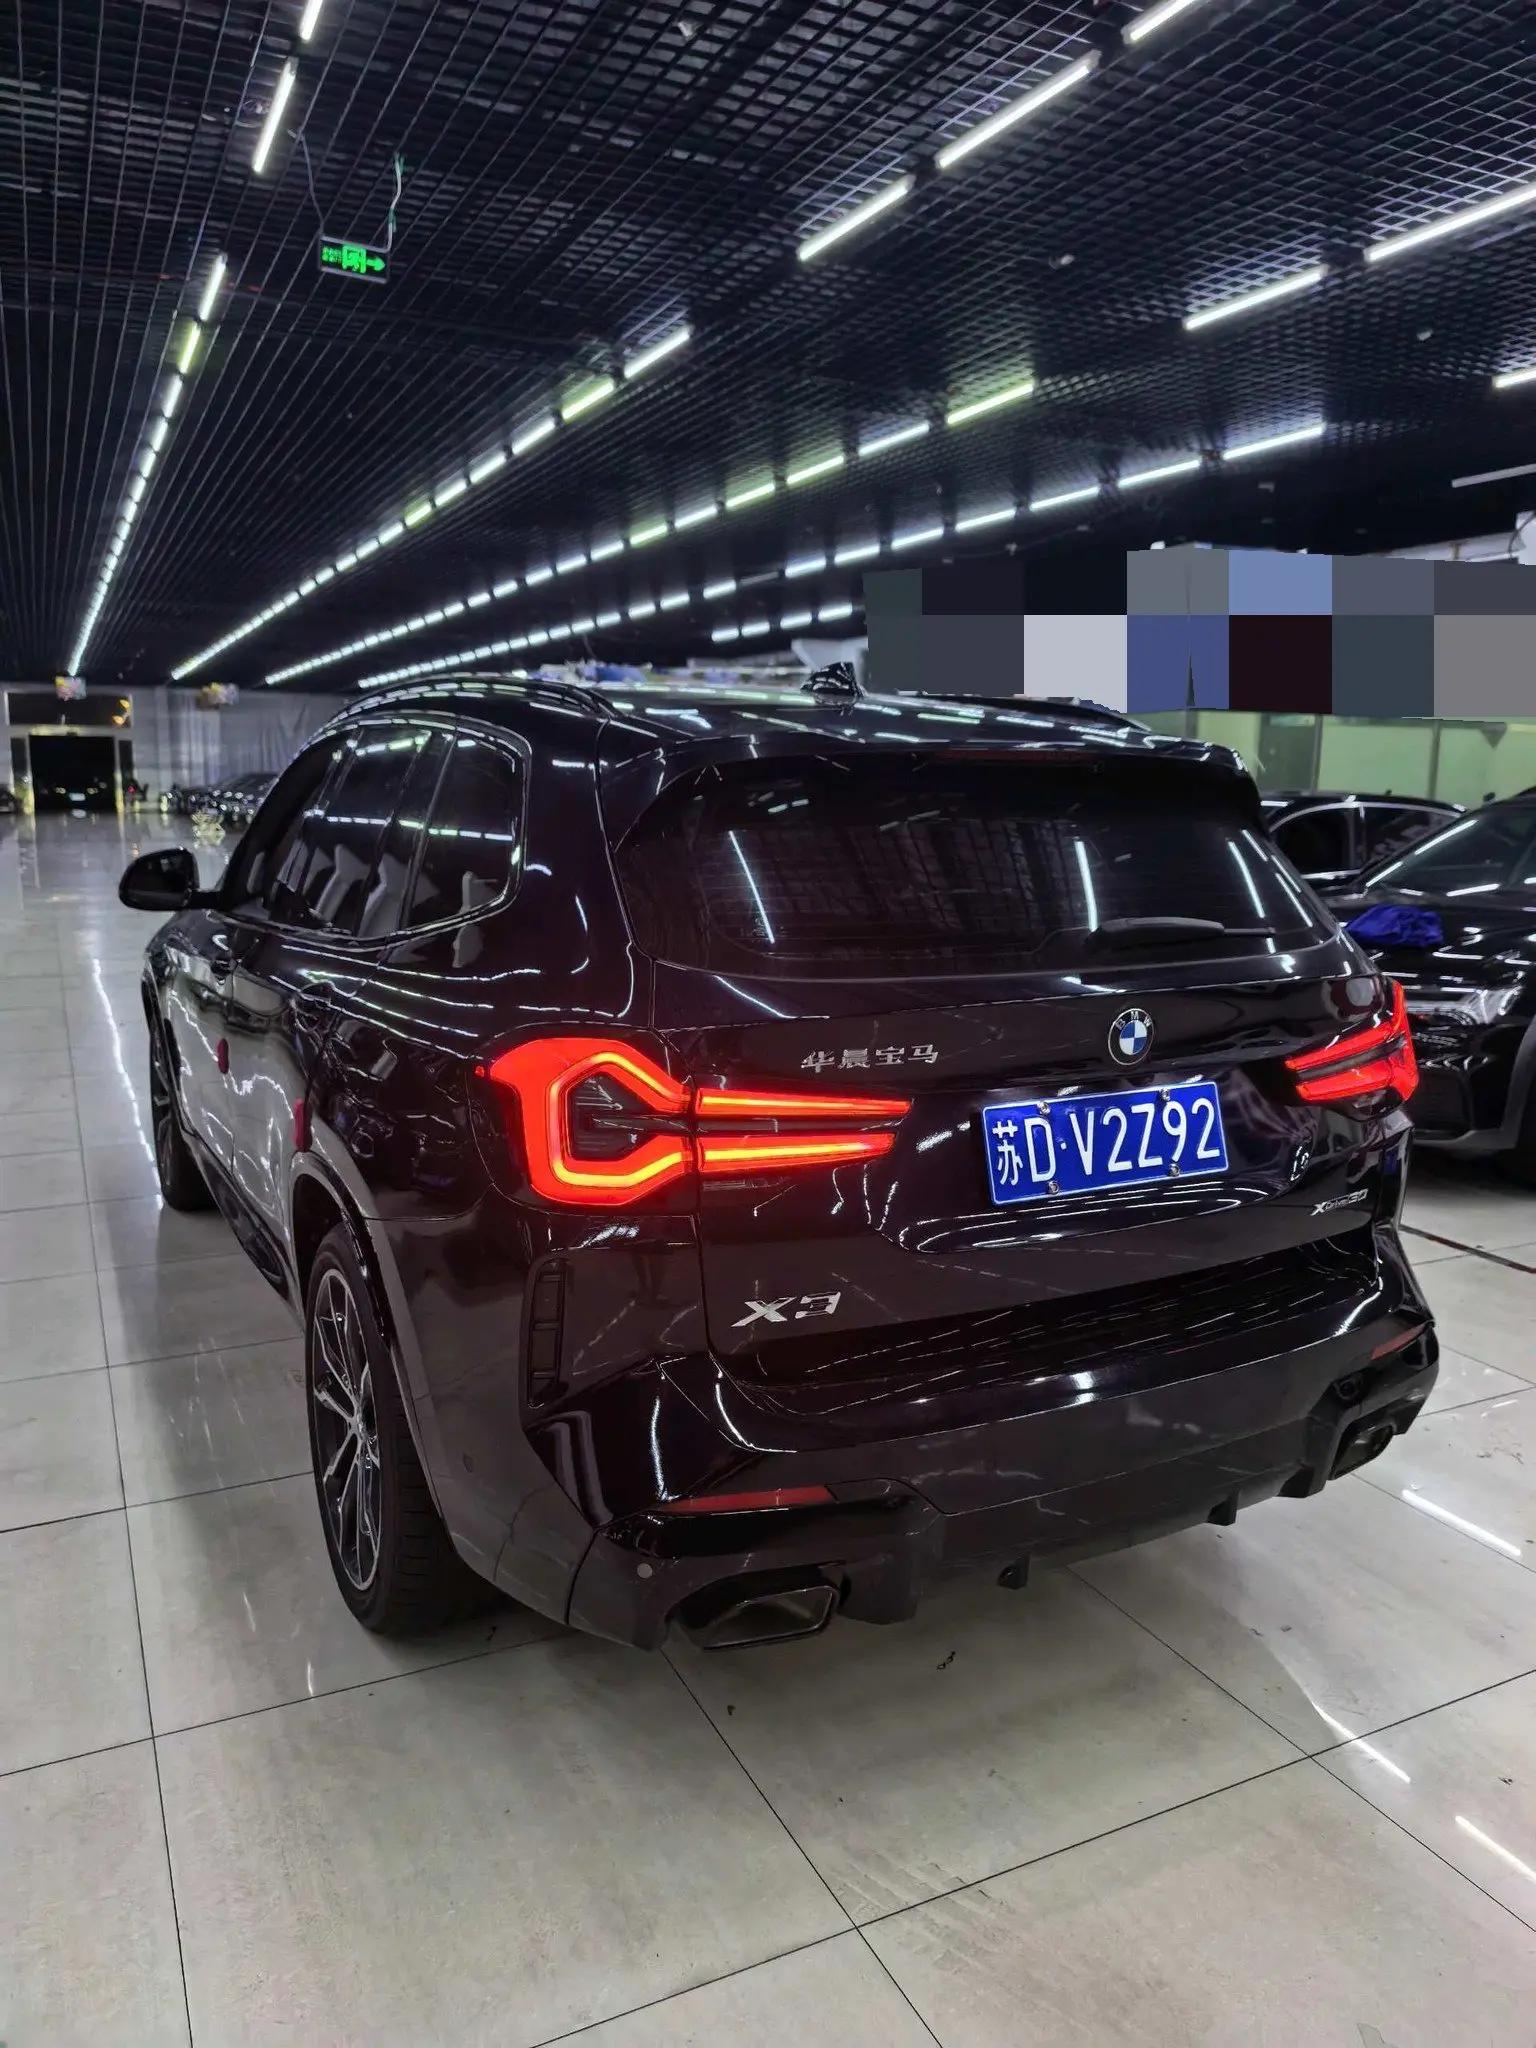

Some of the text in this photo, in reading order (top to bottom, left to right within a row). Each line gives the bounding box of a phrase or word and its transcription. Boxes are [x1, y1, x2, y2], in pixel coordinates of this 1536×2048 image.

[801, 1045, 939, 1073] 华晨宝马
[730, 1291, 841, 1327] X3
